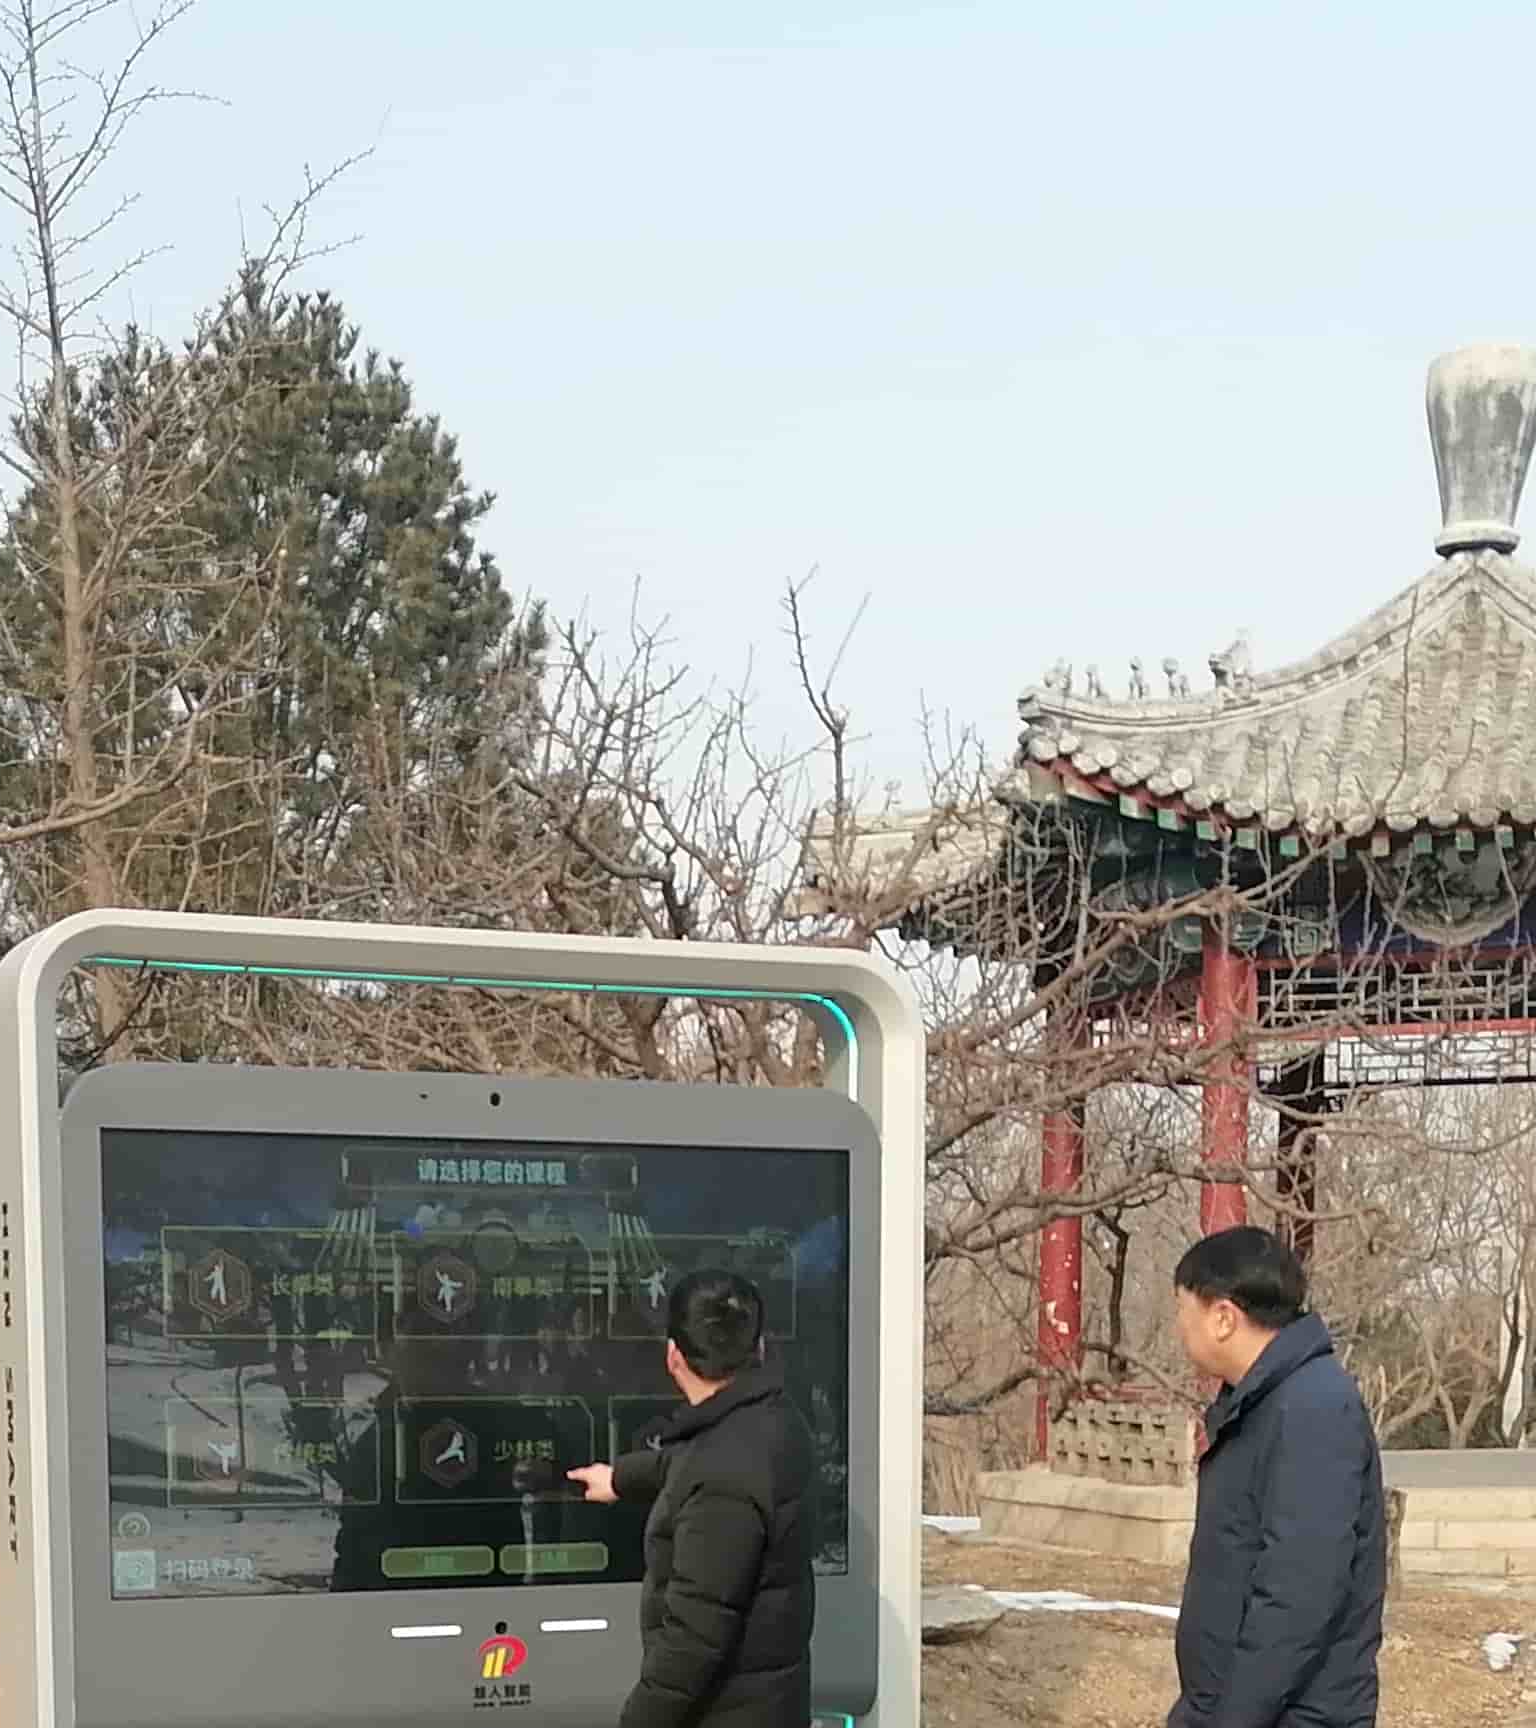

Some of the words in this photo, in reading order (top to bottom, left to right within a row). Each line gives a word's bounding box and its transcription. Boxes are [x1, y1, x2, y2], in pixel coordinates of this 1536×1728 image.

[417, 1158, 567, 1184] 请选择您的课程
[272, 1271, 335, 1297] 长拳类
[493, 1438, 555, 1463] 少林类
[5, 1366, 19, 1564] SMART
[160, 1553, 256, 1584] 扫码登录
